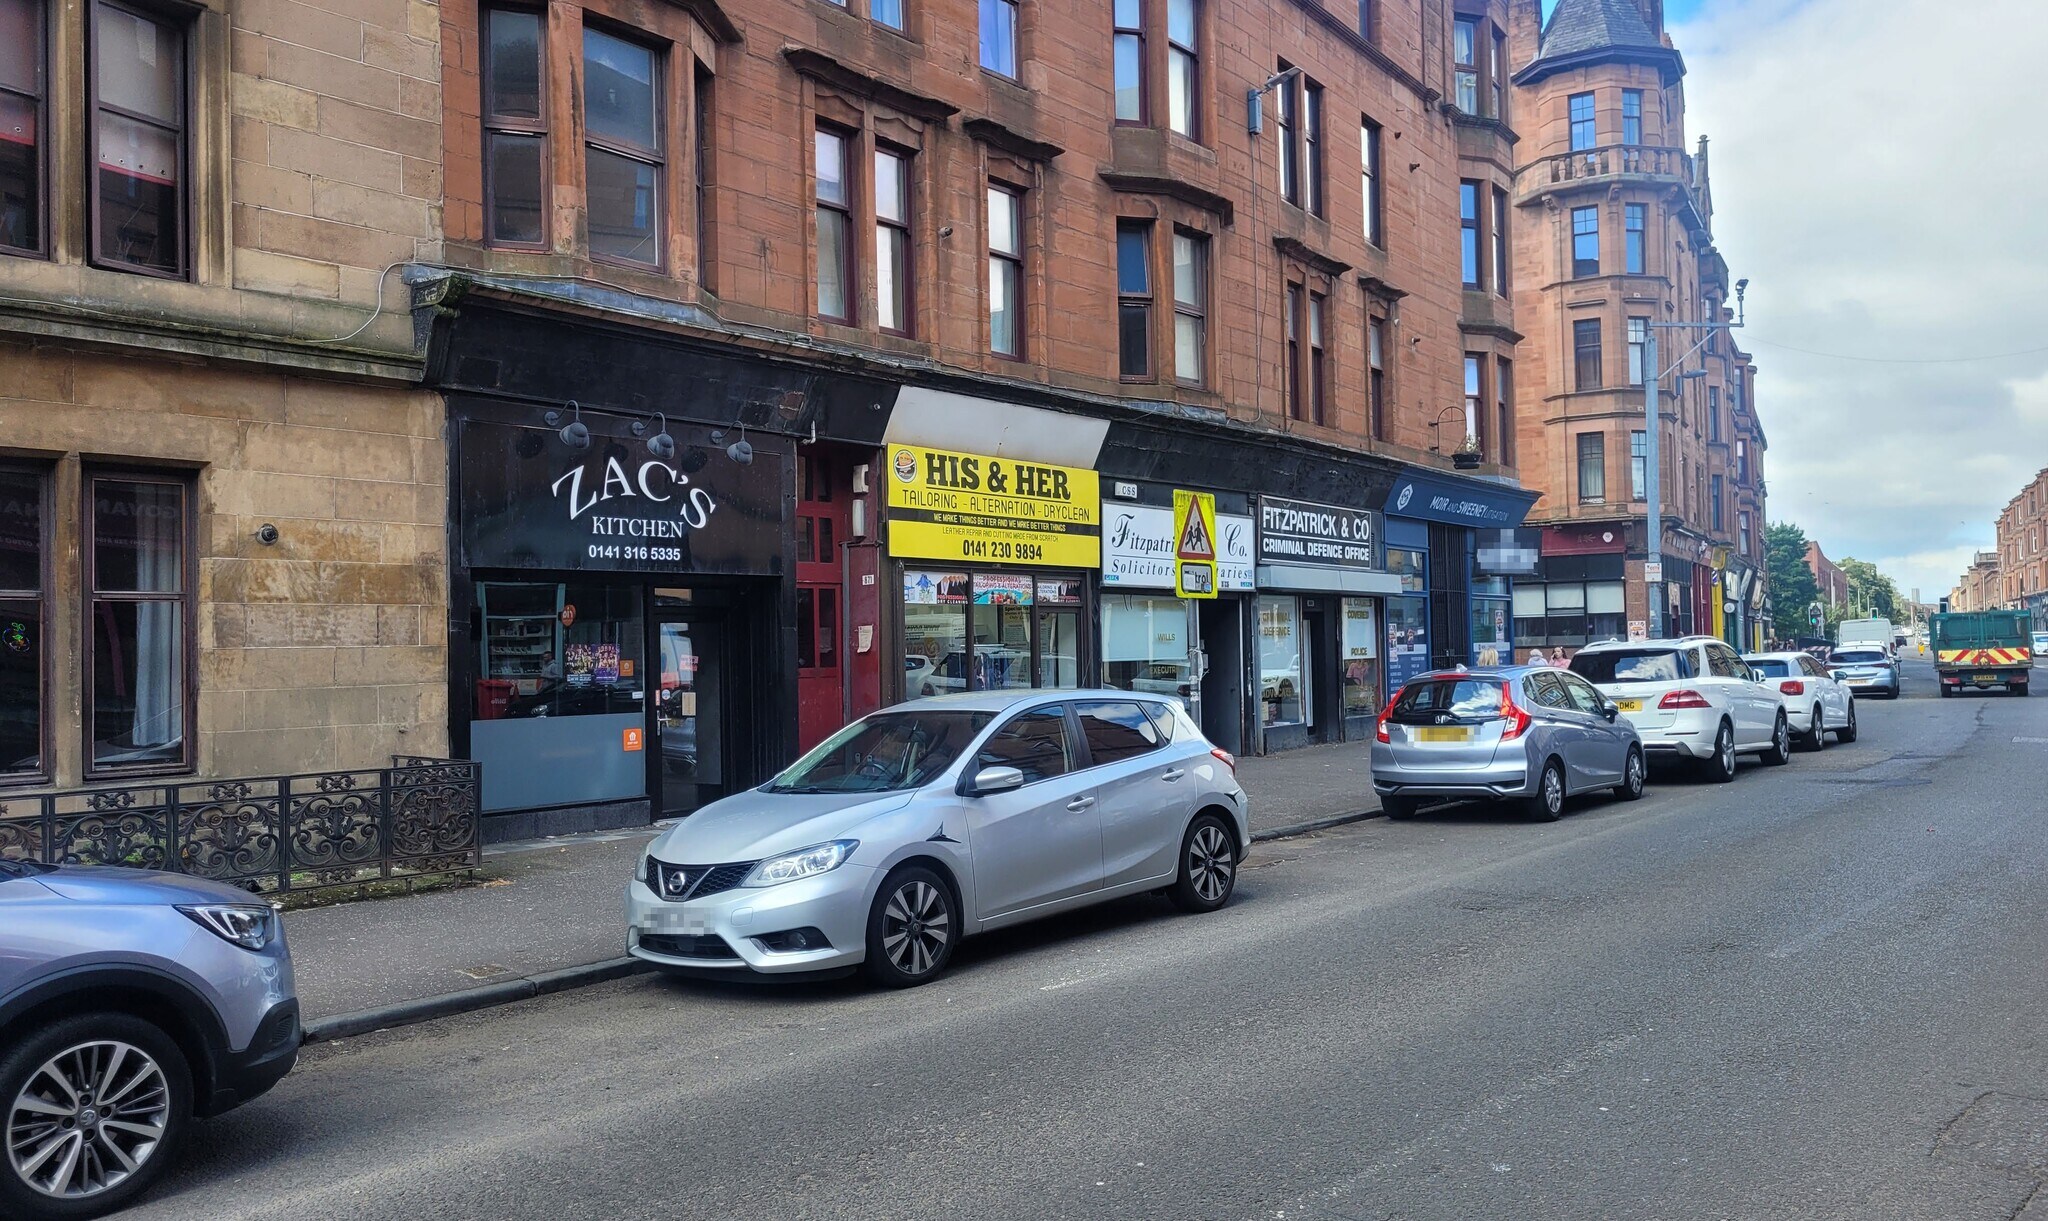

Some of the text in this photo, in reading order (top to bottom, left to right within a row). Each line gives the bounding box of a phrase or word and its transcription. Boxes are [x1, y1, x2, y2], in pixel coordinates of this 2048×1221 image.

[925, 453, 1070, 500] HIS & HER
[552, 456, 716, 529] ZAC'S
[902, 490, 957, 509] TAILORING
[970, 497, 1035, 517] ALTERNATION
[1044, 504, 1089, 522] DRYCLEAN
[1429, 495, 1449, 511] MOIR
[1457, 501, 1488, 518] SWEENEY
[592, 516, 683, 538] KITCHEN
[977, 517, 997, 526] BETTER
[1263, 506, 1369, 539] FITZPATRICK & CO
[1112, 513, 1175, 555] Fitzpatri
[588, 545, 681, 561] 0141 316 5335
[963, 540, 1042, 560] 0141 230 9894
[1263, 538, 1369, 561] CRIMINAL DEFENCE OFFICE
[1195, 571, 1208, 584] trol
[1157, 633, 1176, 641] WILLS
[1150, 666, 1180, 675] EXECUTR
[1619, 701, 1635, 709] DMG
